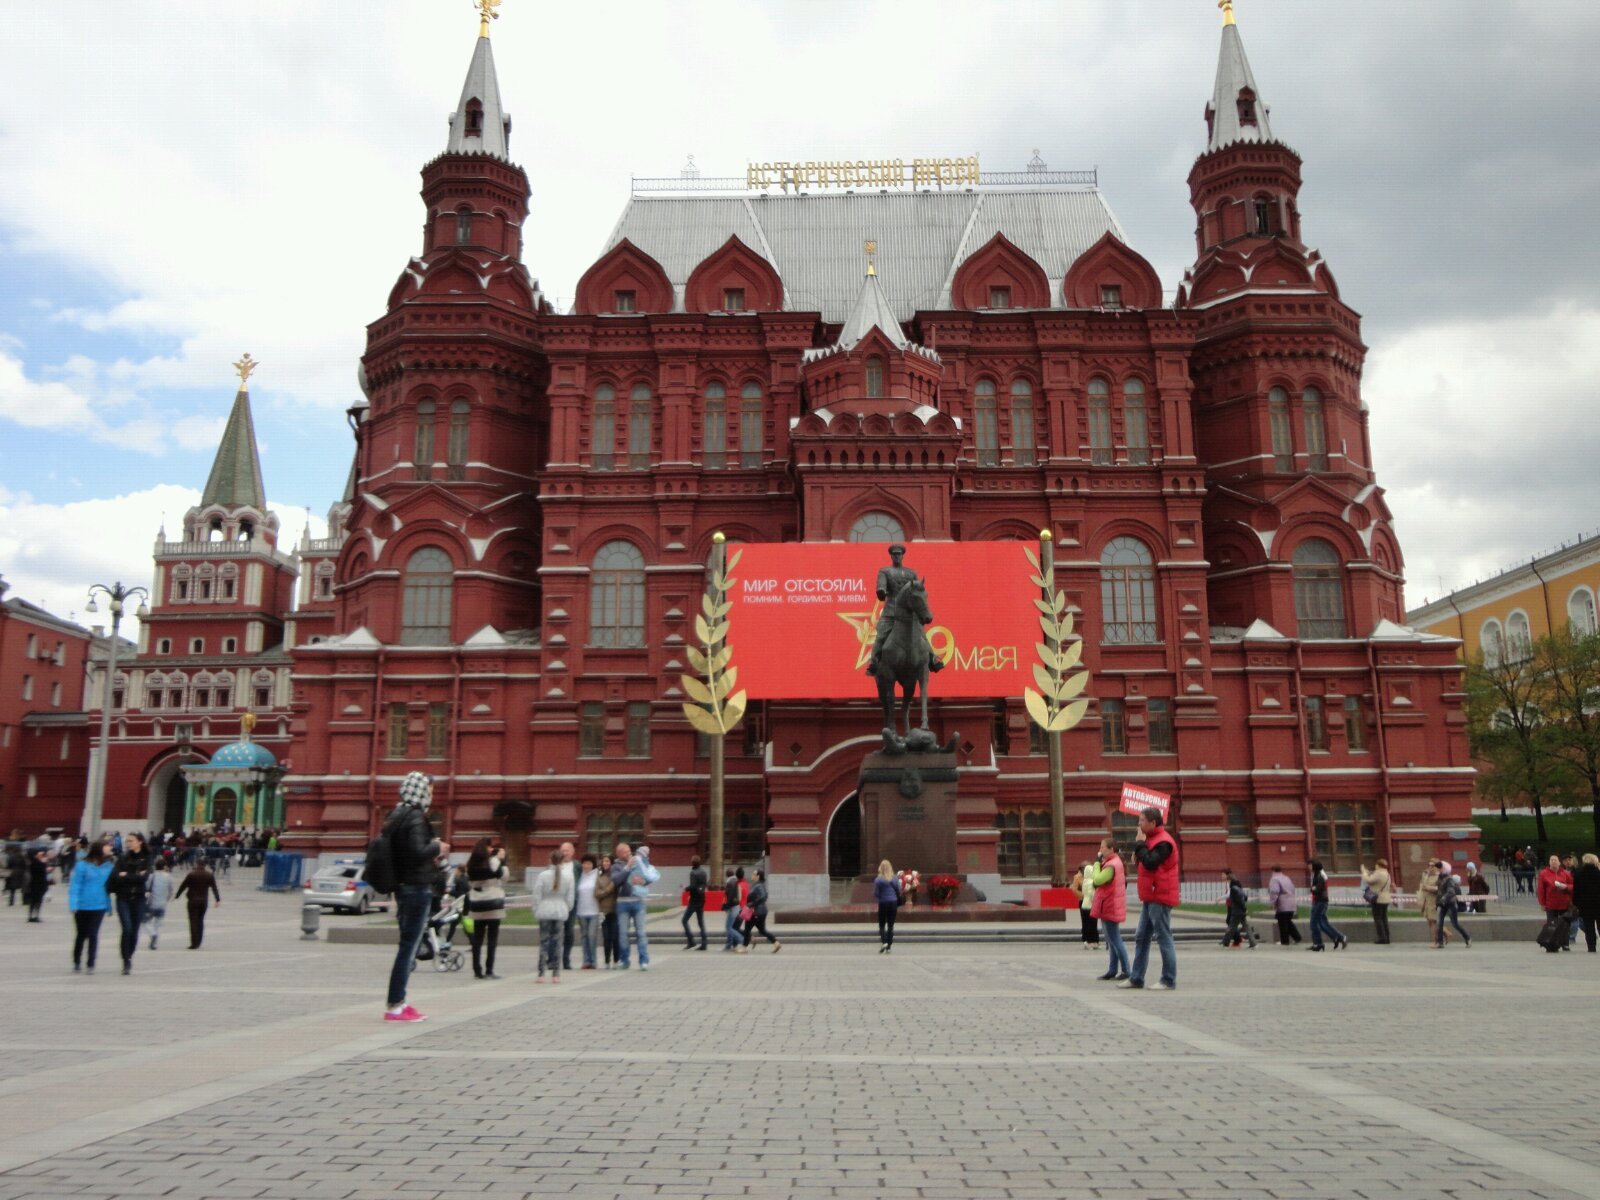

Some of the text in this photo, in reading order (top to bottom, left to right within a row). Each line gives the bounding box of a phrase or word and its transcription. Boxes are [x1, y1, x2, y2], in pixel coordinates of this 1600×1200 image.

[744, 579, 867, 592] МИР ОТСТОЯЛИ.
[926, 625, 955, 667] 9
[1123, 787, 1168, 808] АВТОБУСНЫЕ
